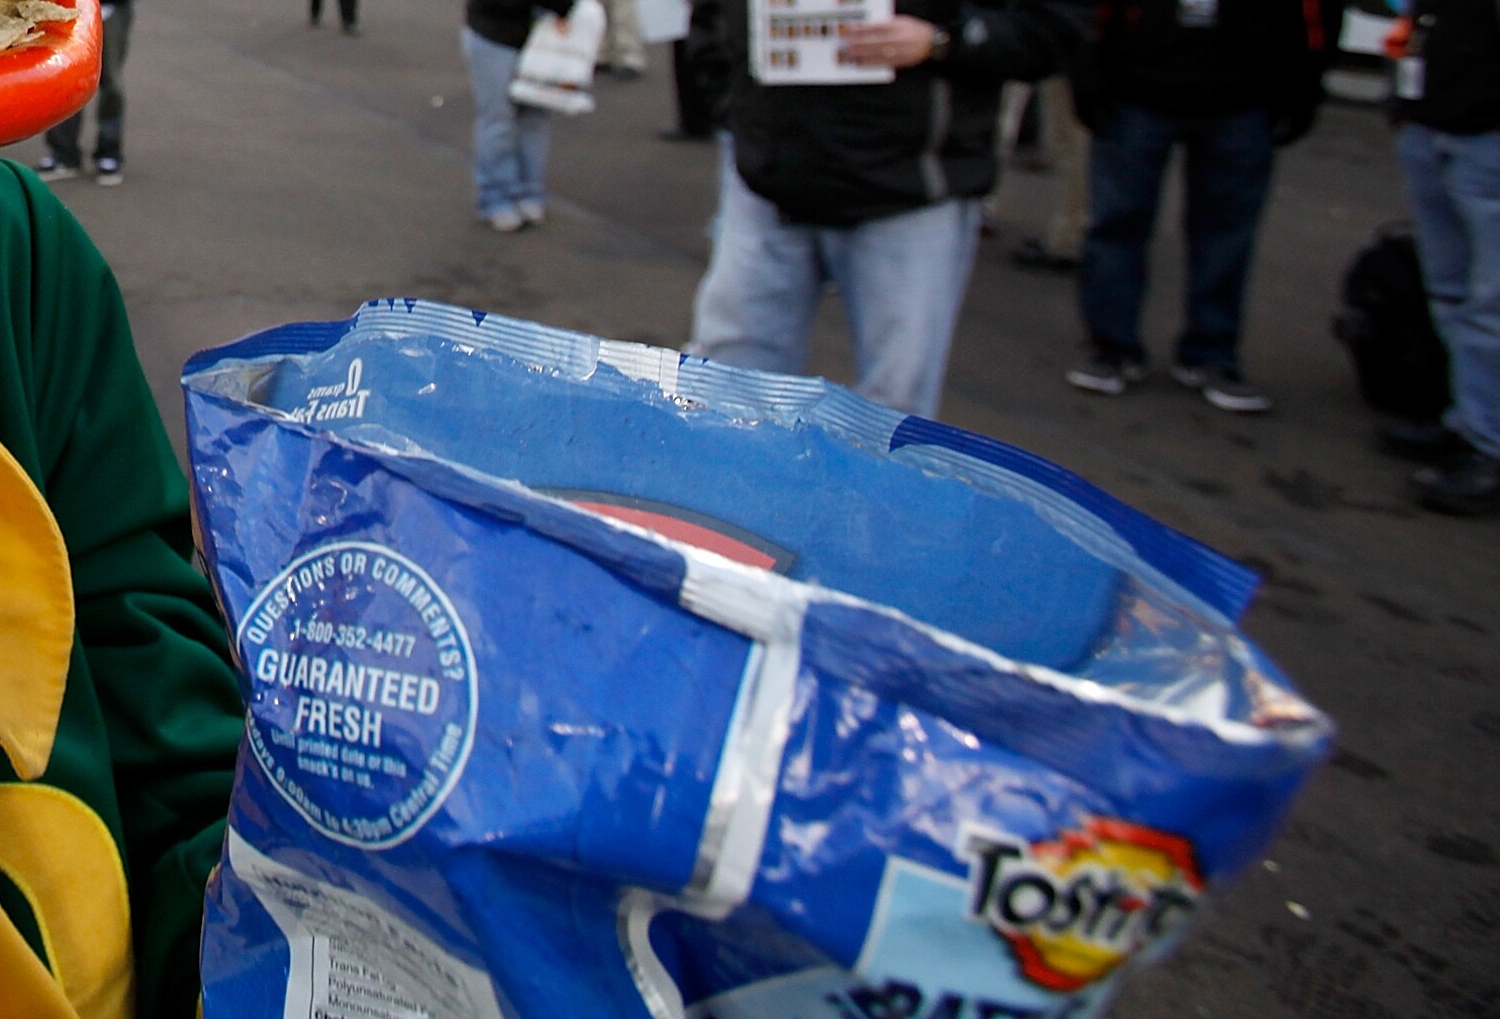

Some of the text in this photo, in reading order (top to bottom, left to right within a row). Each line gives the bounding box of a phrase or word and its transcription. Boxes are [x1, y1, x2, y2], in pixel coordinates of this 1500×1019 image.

[246, 552, 465, 681] QUESTIONS OR COMMENTS?
[292, 619, 416, 659] 1-800-352-4477
[256, 647, 440, 715] GUARANTEED
[294, 695, 383, 748] FRESH
